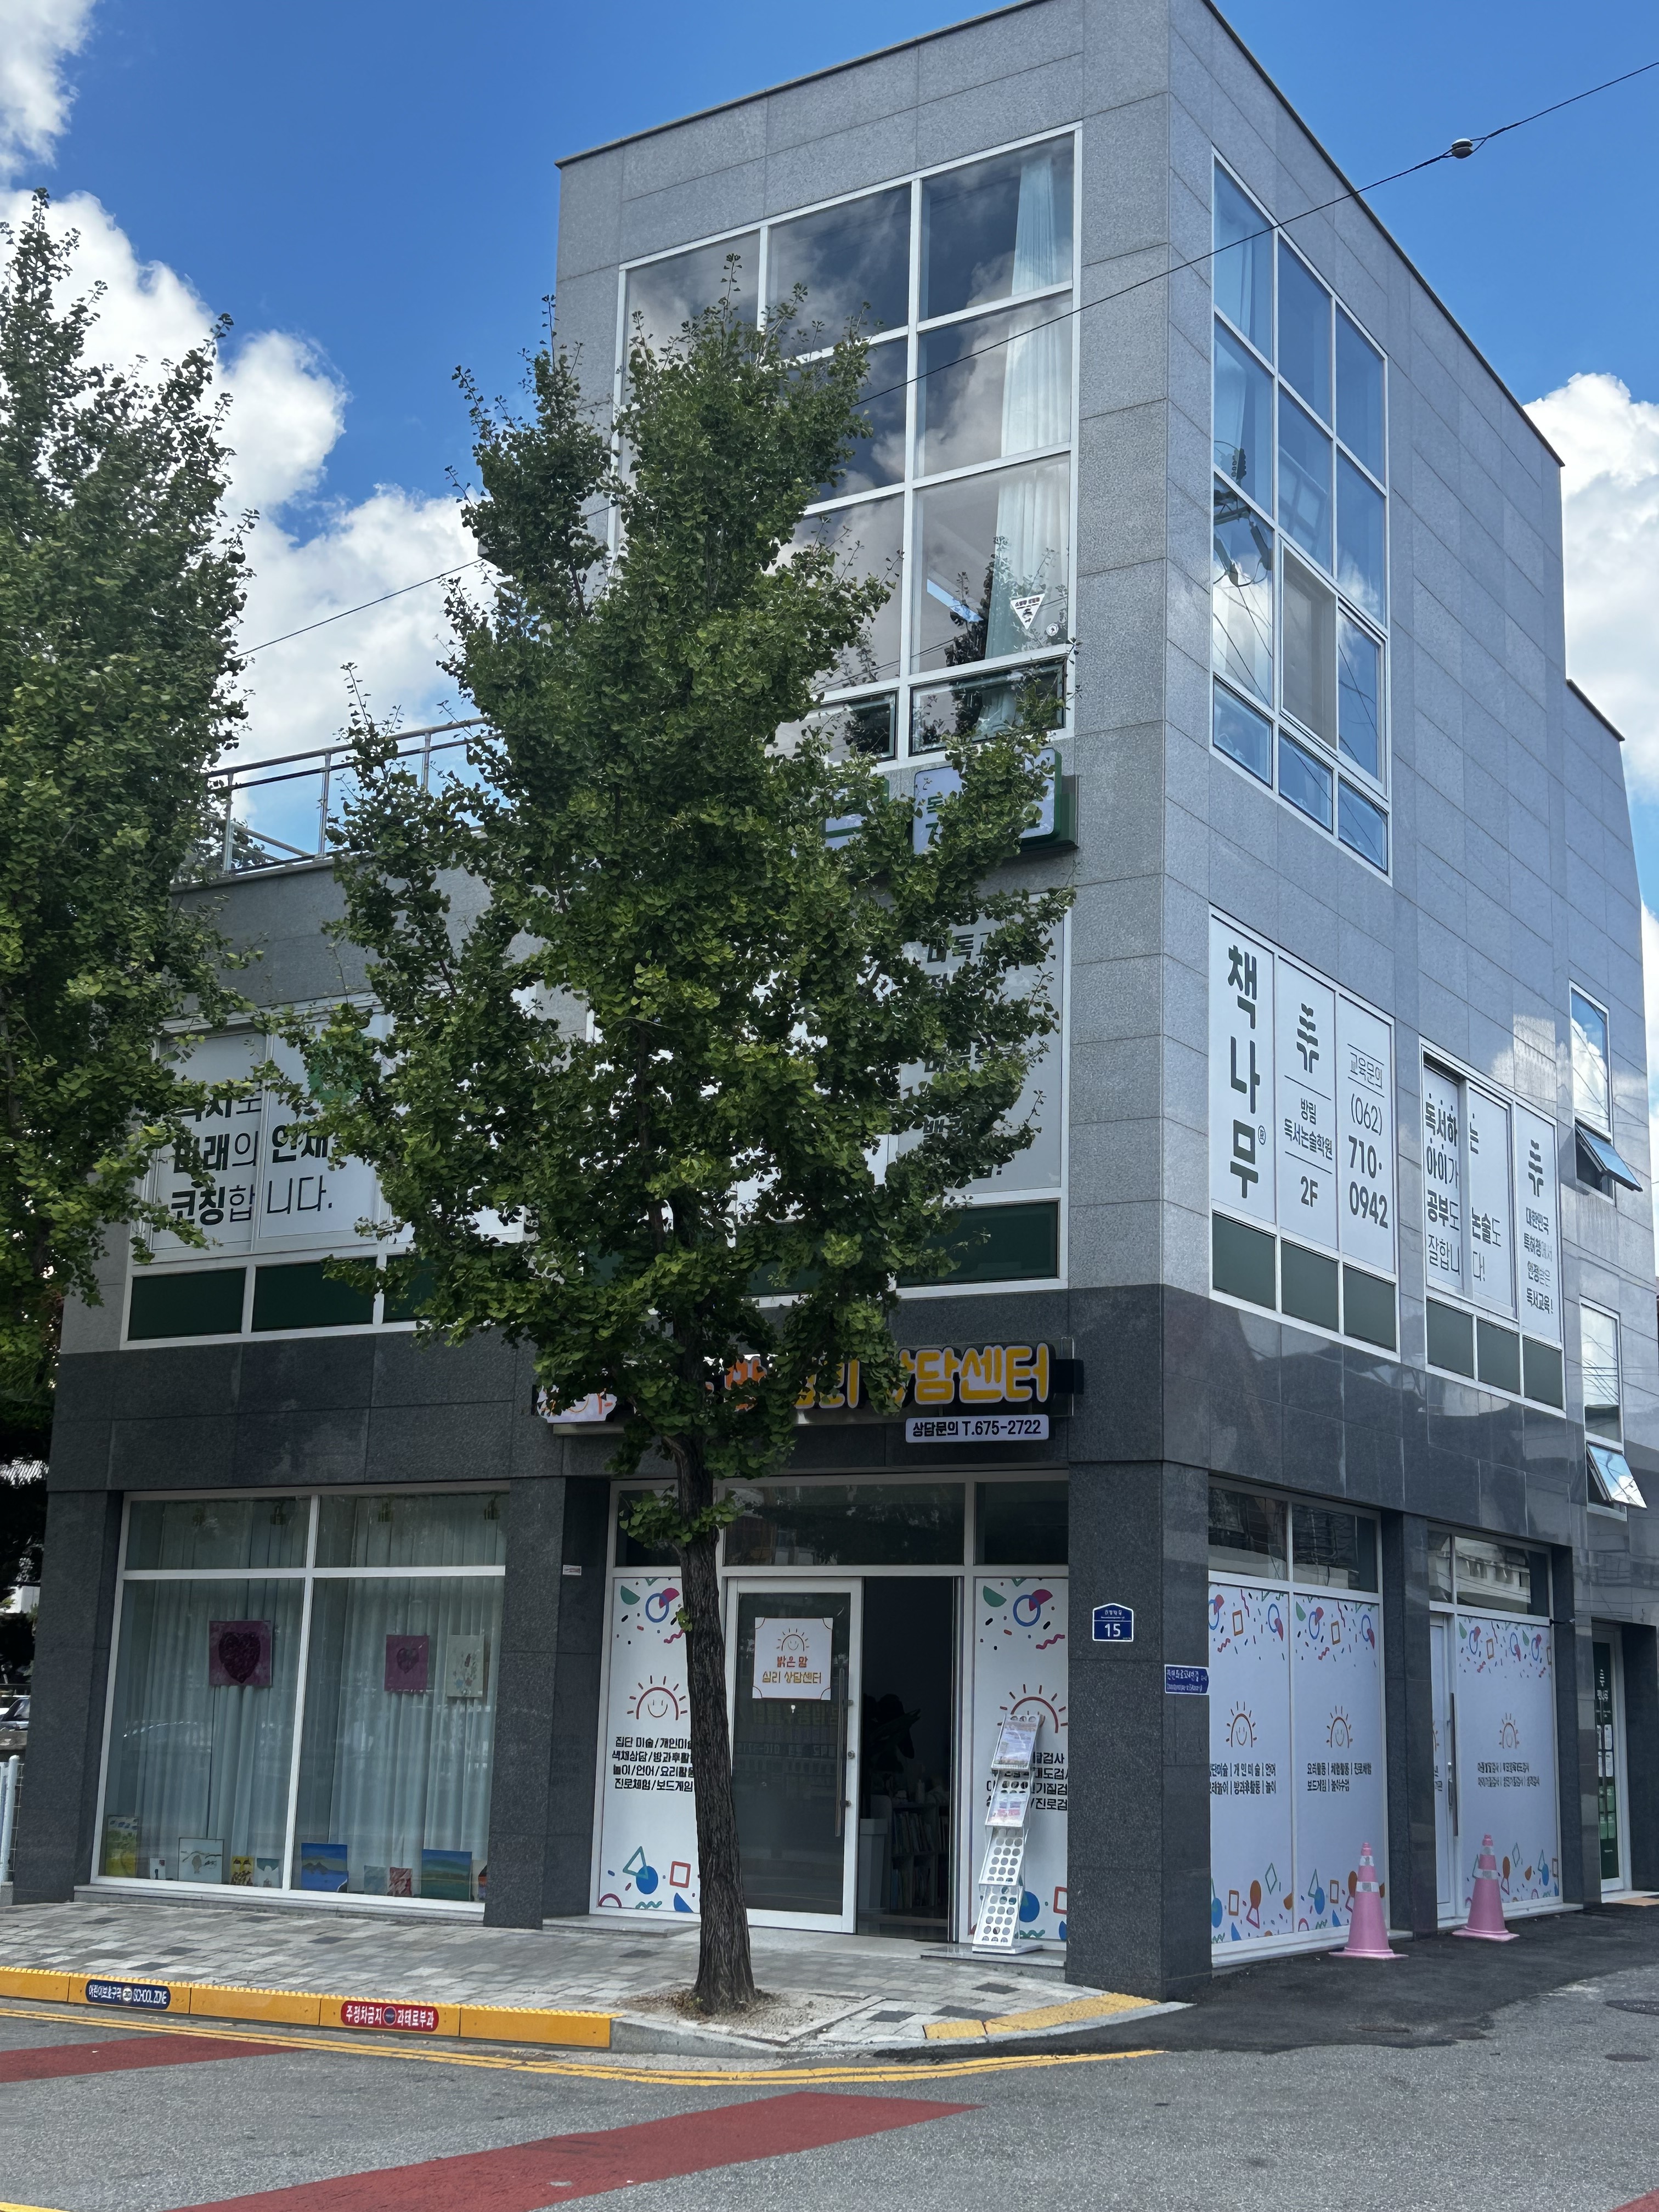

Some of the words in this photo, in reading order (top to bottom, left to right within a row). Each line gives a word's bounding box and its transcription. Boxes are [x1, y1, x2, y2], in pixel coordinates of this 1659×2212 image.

[1228, 945, 1260, 1198] 책나무
[1350, 1052, 1383, 1090] 교육문의
[1300, 1098, 1317, 1125] 방림
[1351, 1093, 1382, 1136] (062)
[1284, 1119, 1333, 1161] 독서논술학원
[1426, 1144, 1458, 1189] 아이가
[1301, 1176, 1318, 1207] 2F
[1350, 1181, 1389, 1229] 0942
[1427, 1189, 1460, 1232] 공부도
[1472, 1207, 1502, 1248] 논술도
[913, 1421, 958, 1437] 상담문의
[1105, 1623, 1121, 1638] 15
[777, 1655, 795, 1668] 밝은
[762, 1671, 781, 1684] 심리
[784, 1671, 822, 1684] 상담센터
[616, 1736, 633, 1748] 집단
[612, 1750, 692, 1764] 색채상담/방과후활
[346, 2005, 382, 2025] 주정차금지
[397, 2008, 435, 2029] 과태료부과
